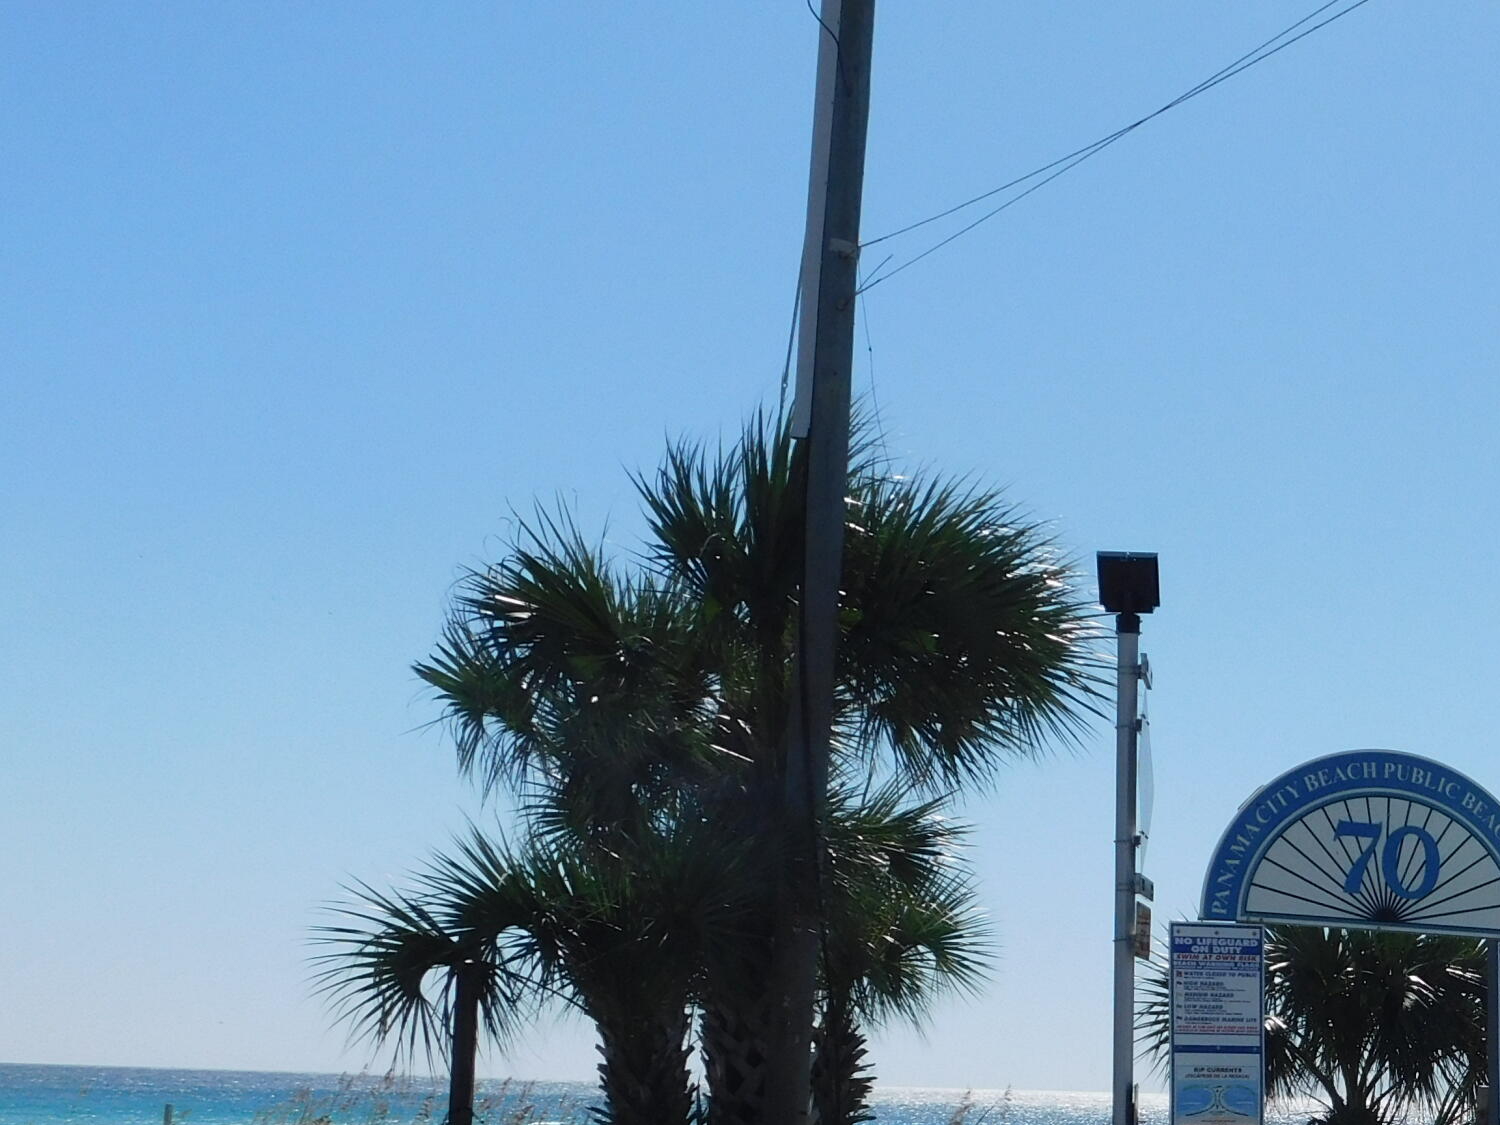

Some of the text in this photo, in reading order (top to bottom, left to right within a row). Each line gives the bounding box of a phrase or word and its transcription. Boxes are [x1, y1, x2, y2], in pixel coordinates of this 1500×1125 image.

[1211, 823, 1261, 915] PANAMA
[1255, 780, 1300, 824] CITY
[1303, 762, 1376, 792] BEACH
[1384, 762, 1461, 800] PUBLIC
[1333, 819, 1440, 900] 70
[1174, 937, 1258, 947] NO LIFEGUARD
[1191, 945, 1242, 954] ON DUTY
